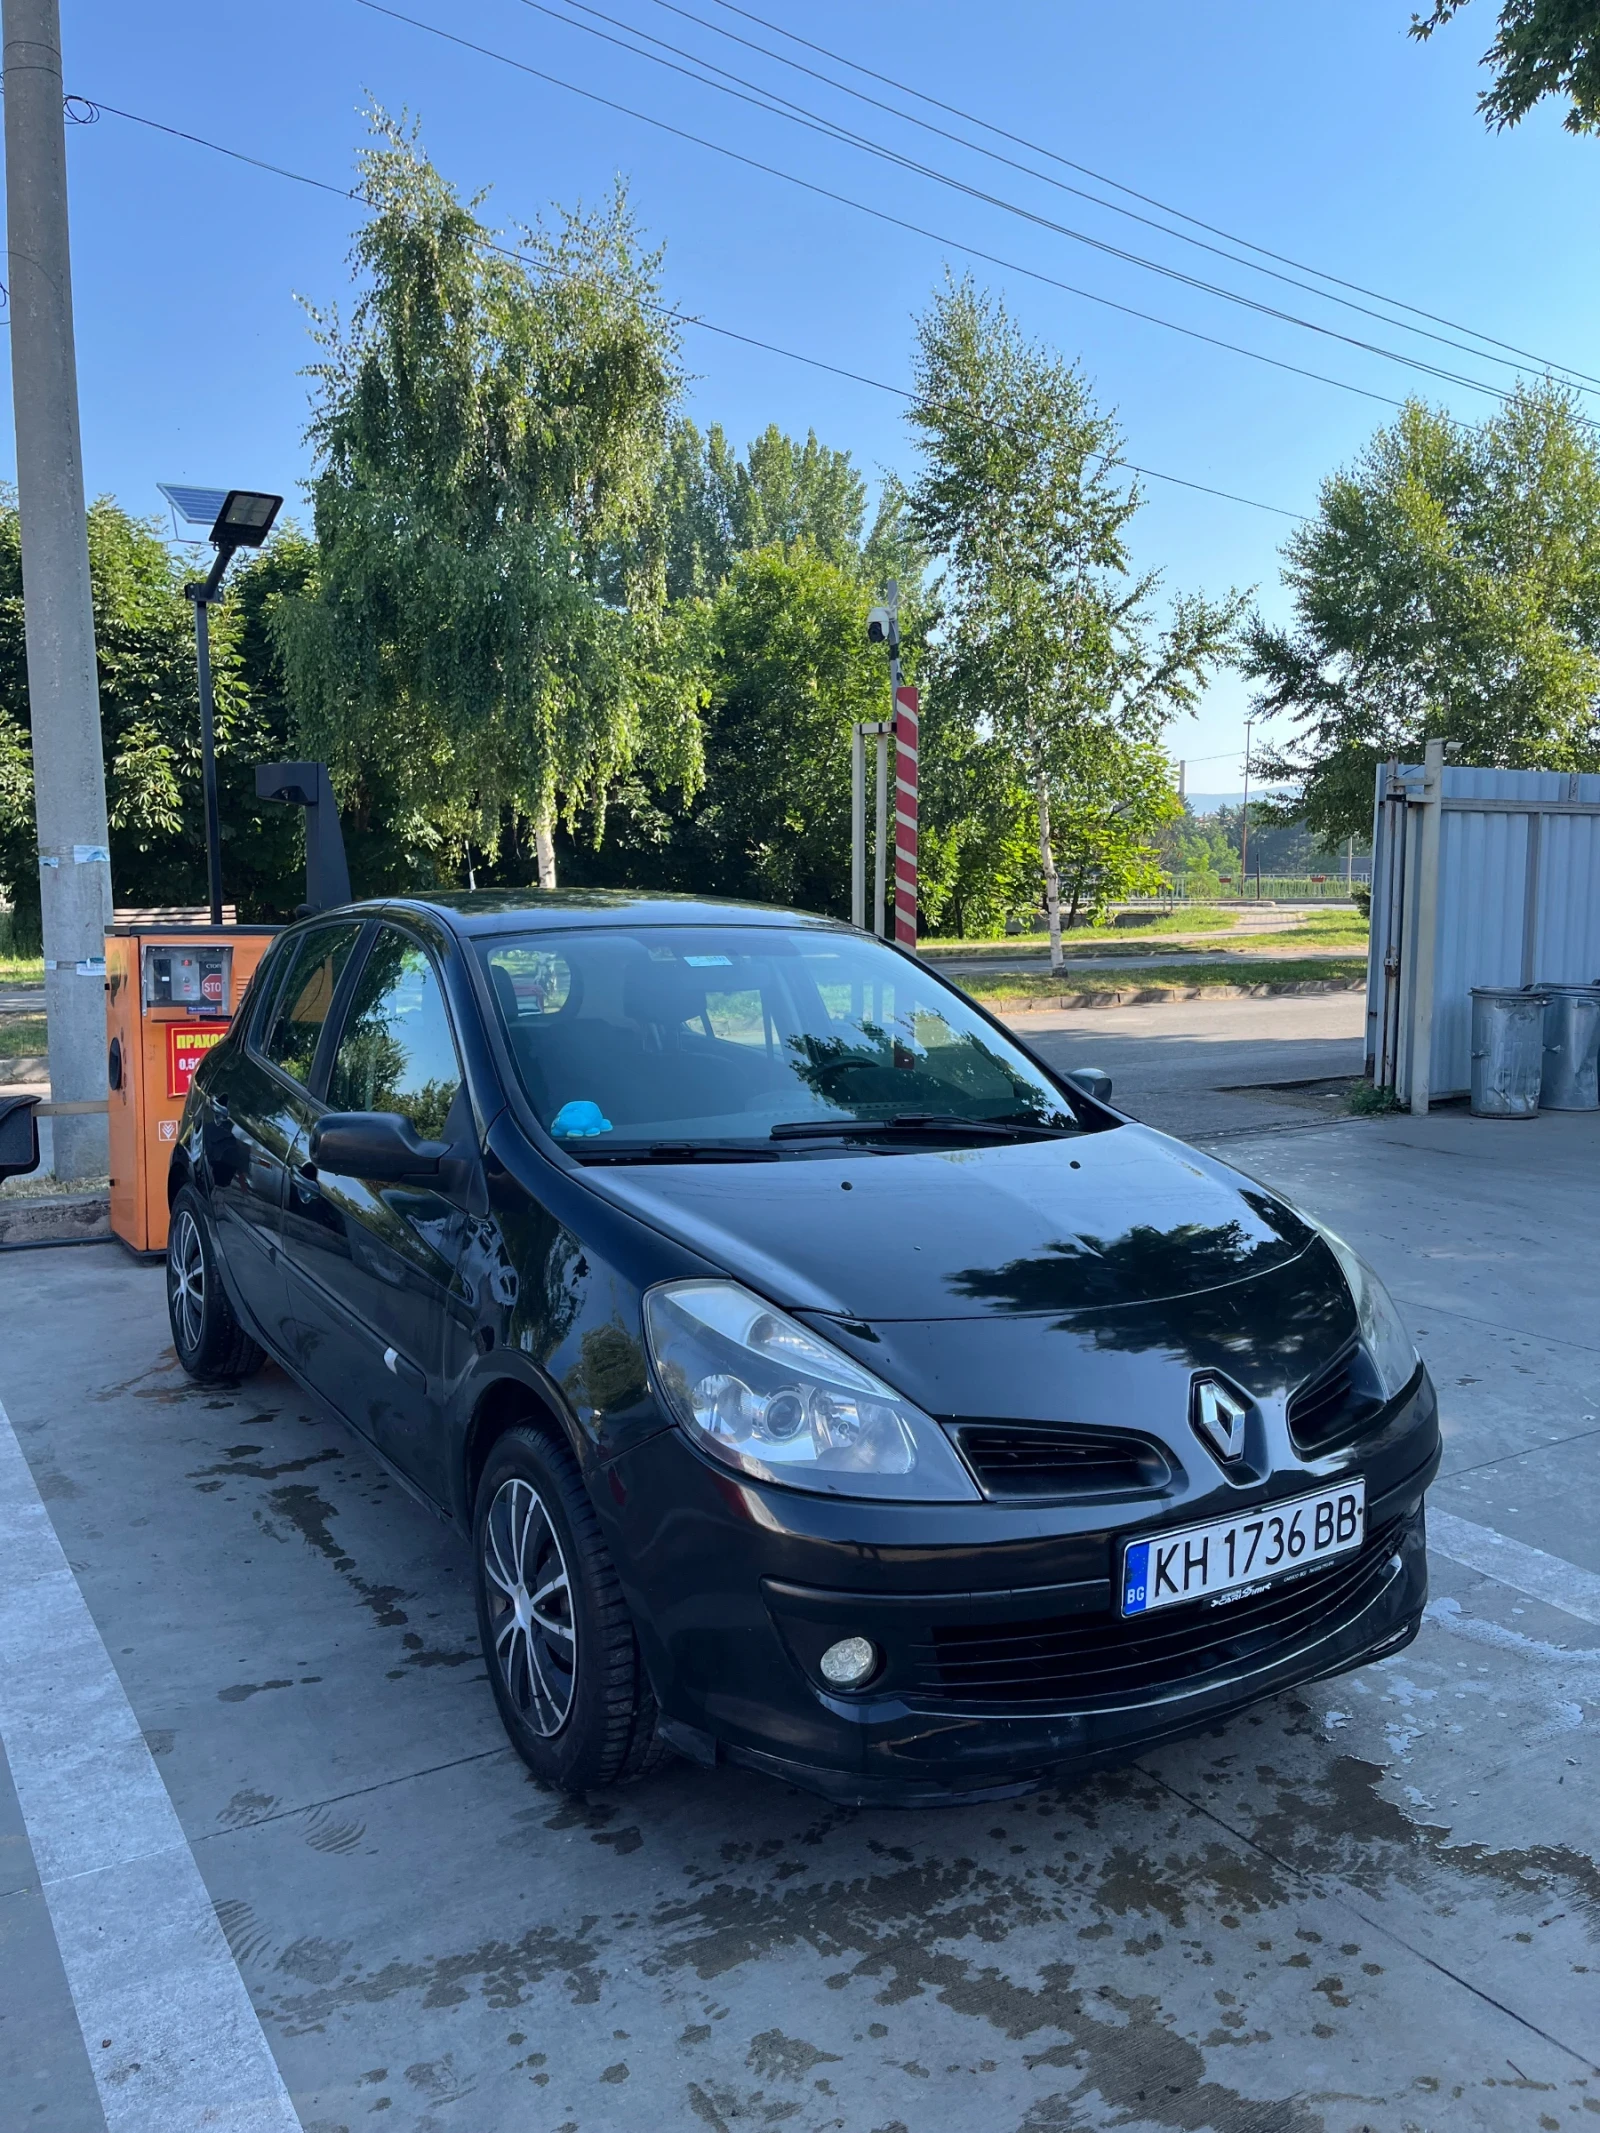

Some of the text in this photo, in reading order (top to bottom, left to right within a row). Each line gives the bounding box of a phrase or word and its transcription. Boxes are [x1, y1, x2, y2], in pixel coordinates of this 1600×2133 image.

[204, 982, 221, 993] STO
[1154, 1536, 1209, 1598] KH
[1224, 1508, 1306, 1578] 1736
[1314, 1494, 1357, 1551] BB
[1126, 1586, 1145, 1605] BG
